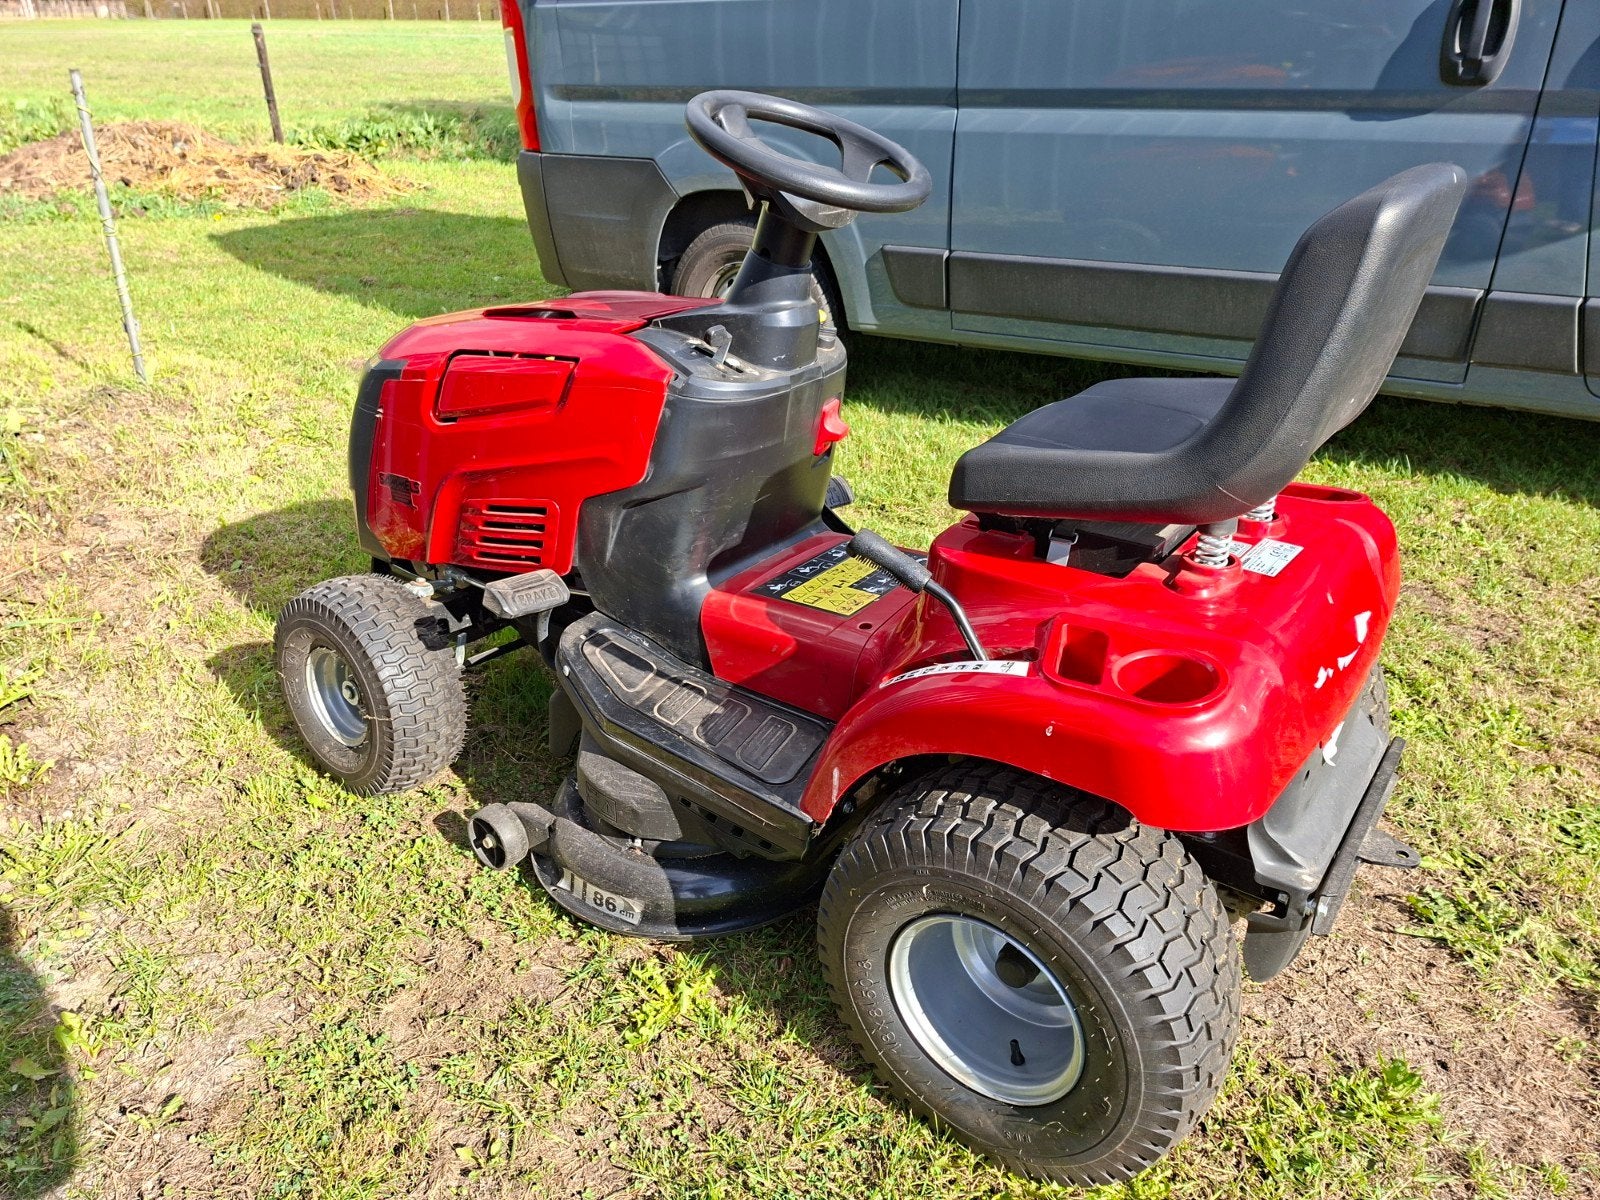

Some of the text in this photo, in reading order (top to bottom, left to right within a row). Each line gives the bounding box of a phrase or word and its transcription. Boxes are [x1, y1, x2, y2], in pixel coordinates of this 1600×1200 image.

[517, 587, 556, 605] BRAKE
[593, 891, 635, 919] 86 cm
